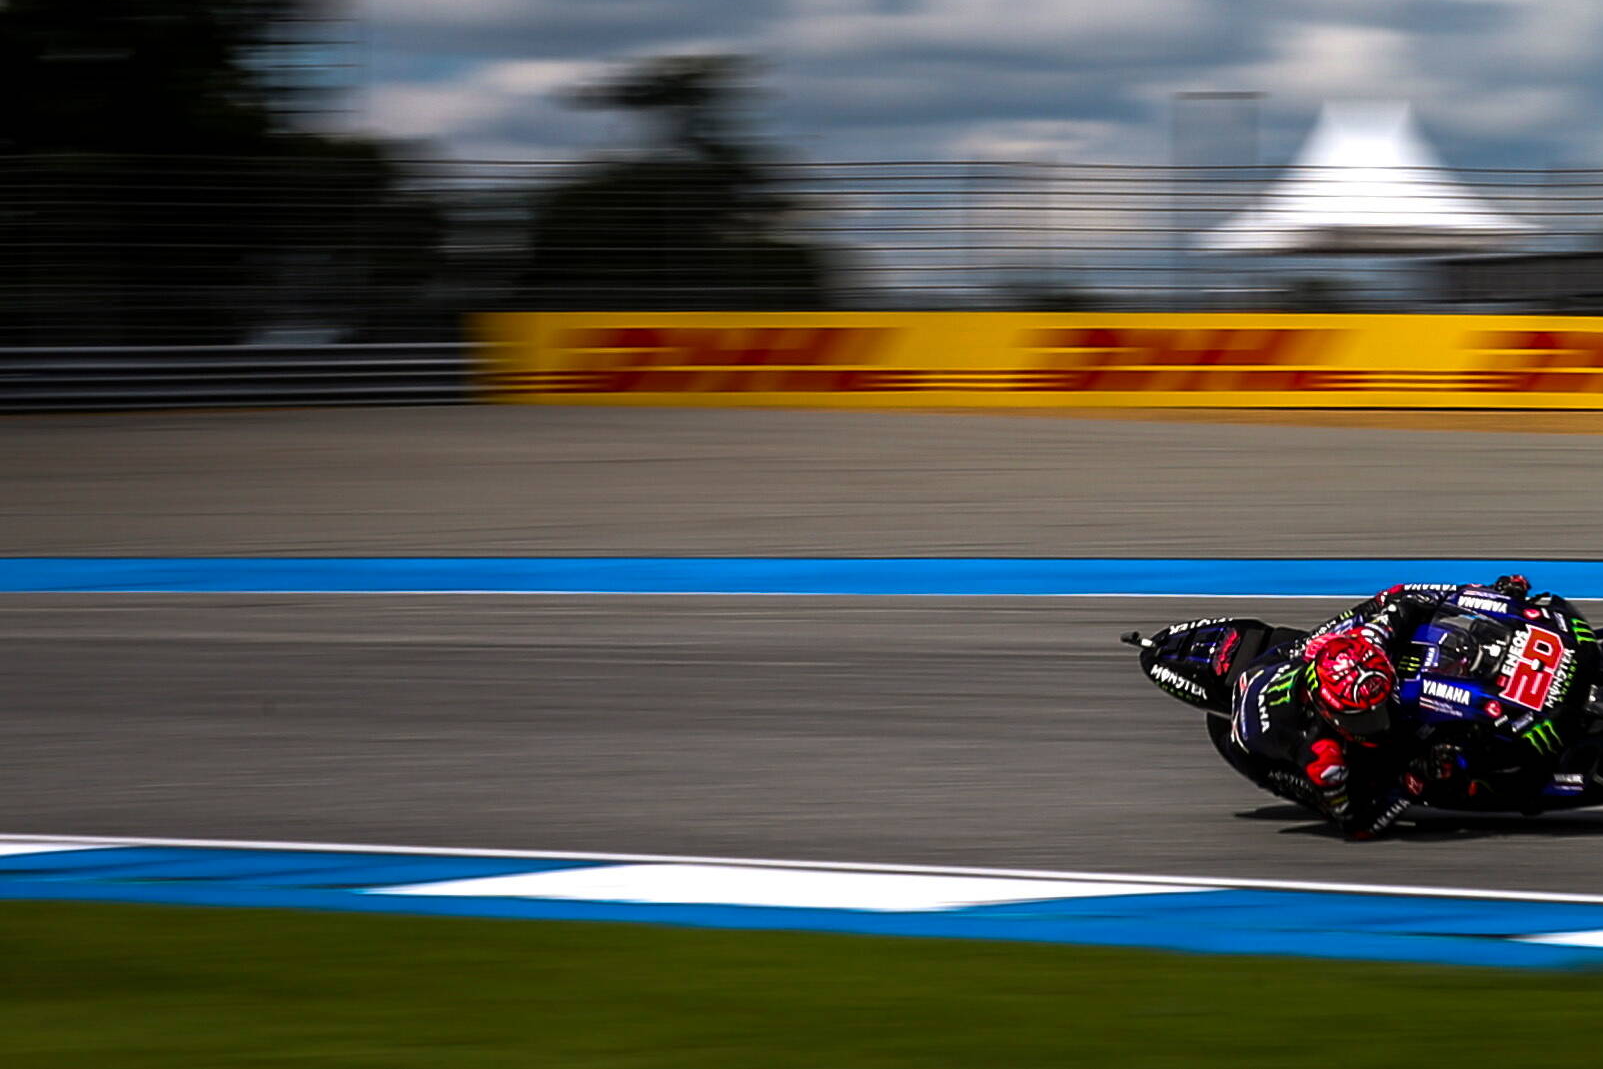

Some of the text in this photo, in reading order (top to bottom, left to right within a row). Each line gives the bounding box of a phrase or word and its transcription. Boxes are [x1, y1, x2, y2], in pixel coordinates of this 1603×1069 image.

[1457, 595, 1508, 614] YAMAHA
[1501, 629, 1529, 676] ENEOS
[1423, 679, 1471, 706] YAMAHA
